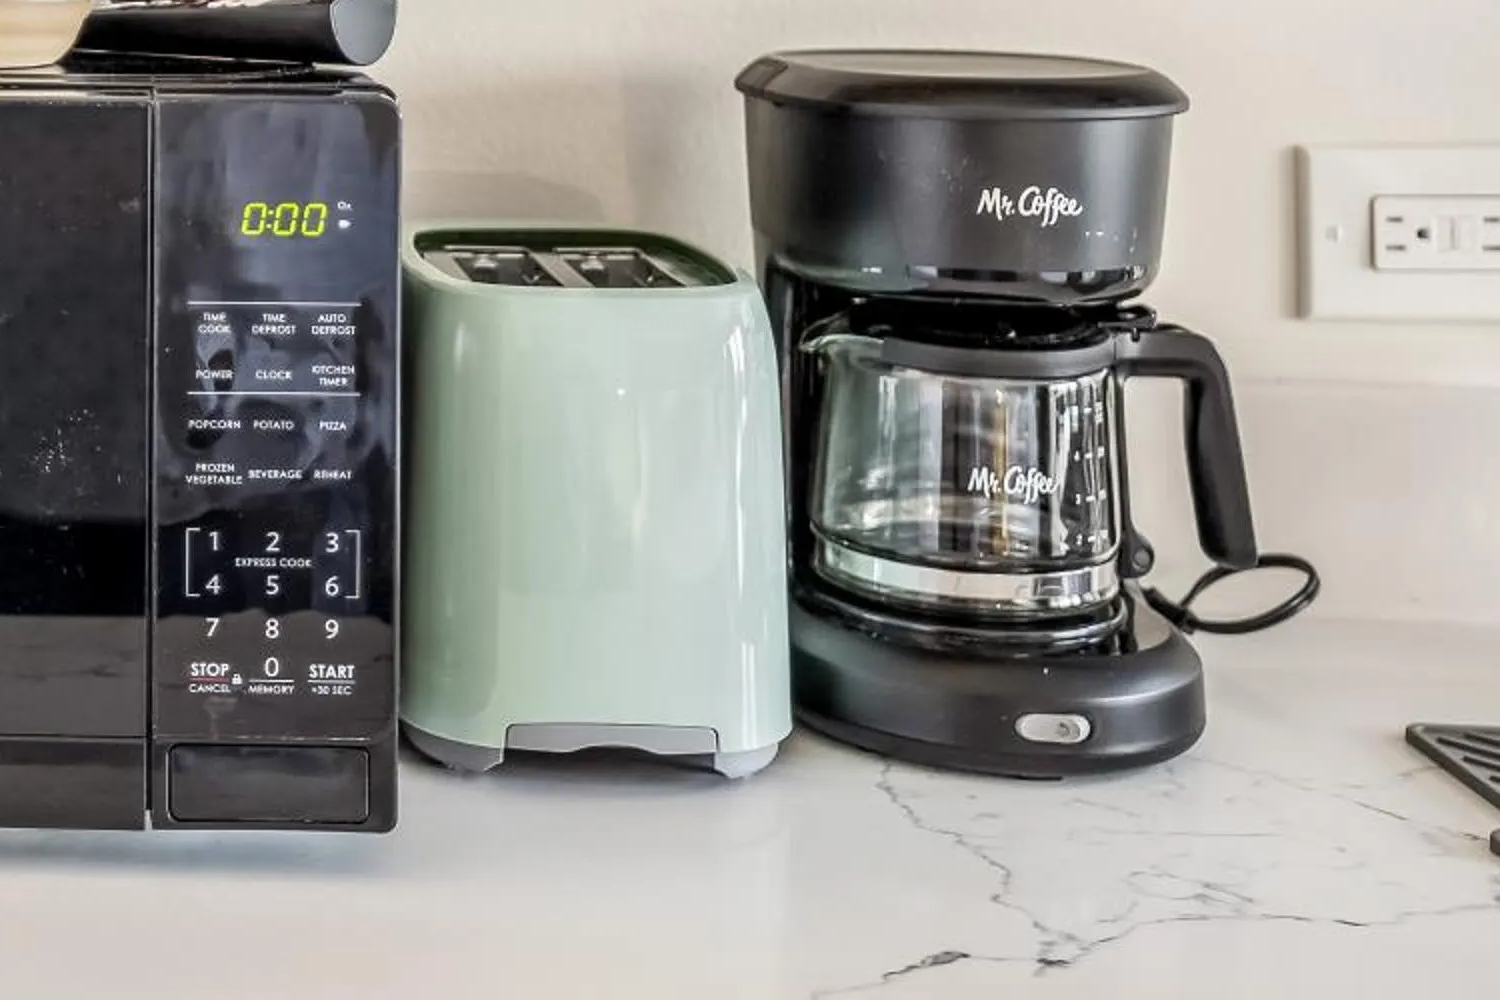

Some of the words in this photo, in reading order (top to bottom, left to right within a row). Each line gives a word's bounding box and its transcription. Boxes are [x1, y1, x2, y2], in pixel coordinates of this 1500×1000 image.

[976, 187, 1016, 221] Mr.
[1018, 185, 1083, 228] Coffee
[241, 202, 328, 237] 0:00
[203, 312, 228, 322] TIME
[262, 313, 287, 323] TIME
[317, 313, 347, 323] AUTO
[197, 323, 232, 334] COOK
[251, 324, 297, 335] DEFROST
[311, 325, 357, 335] DEFROST
[195, 369, 233, 379] POWER
[255, 369, 293, 380] CLOCK
[311, 365, 356, 375] KITCHEN
[319, 377, 349, 386] TIMER
[187, 419, 242, 430] POPCORN
[252, 419, 295, 430] POTATO
[319, 421, 347, 431] PIZZA
[195, 463, 235, 473] FROZEN
[185, 475, 243, 485] VEGETABLE
[248, 469, 303, 480] BEVERAGE
[313, 470, 352, 480] REHEAT
[967, 466, 1002, 499] Mr.
[1004, 465, 1061, 505] Coffee
[208, 531, 219, 551] 1
[265, 532, 281, 551] 2
[325, 533, 339, 552] 3
[235, 557, 277, 567] EXPRESS
[205, 574, 221, 594] 4
[265, 575, 280, 595] 5
[325, 576, 339, 596] 6
[205, 618, 220, 637] 7
[265, 619, 280, 638] 8
[325, 619, 339, 639] 9
[190, 663, 229, 677] STOP
[264, 657, 279, 677] 0
[309, 664, 355, 679] START
[188, 684, 231, 693] CANCEL
[248, 685, 295, 695] MEMORY
[332, 686, 353, 695] SEC
